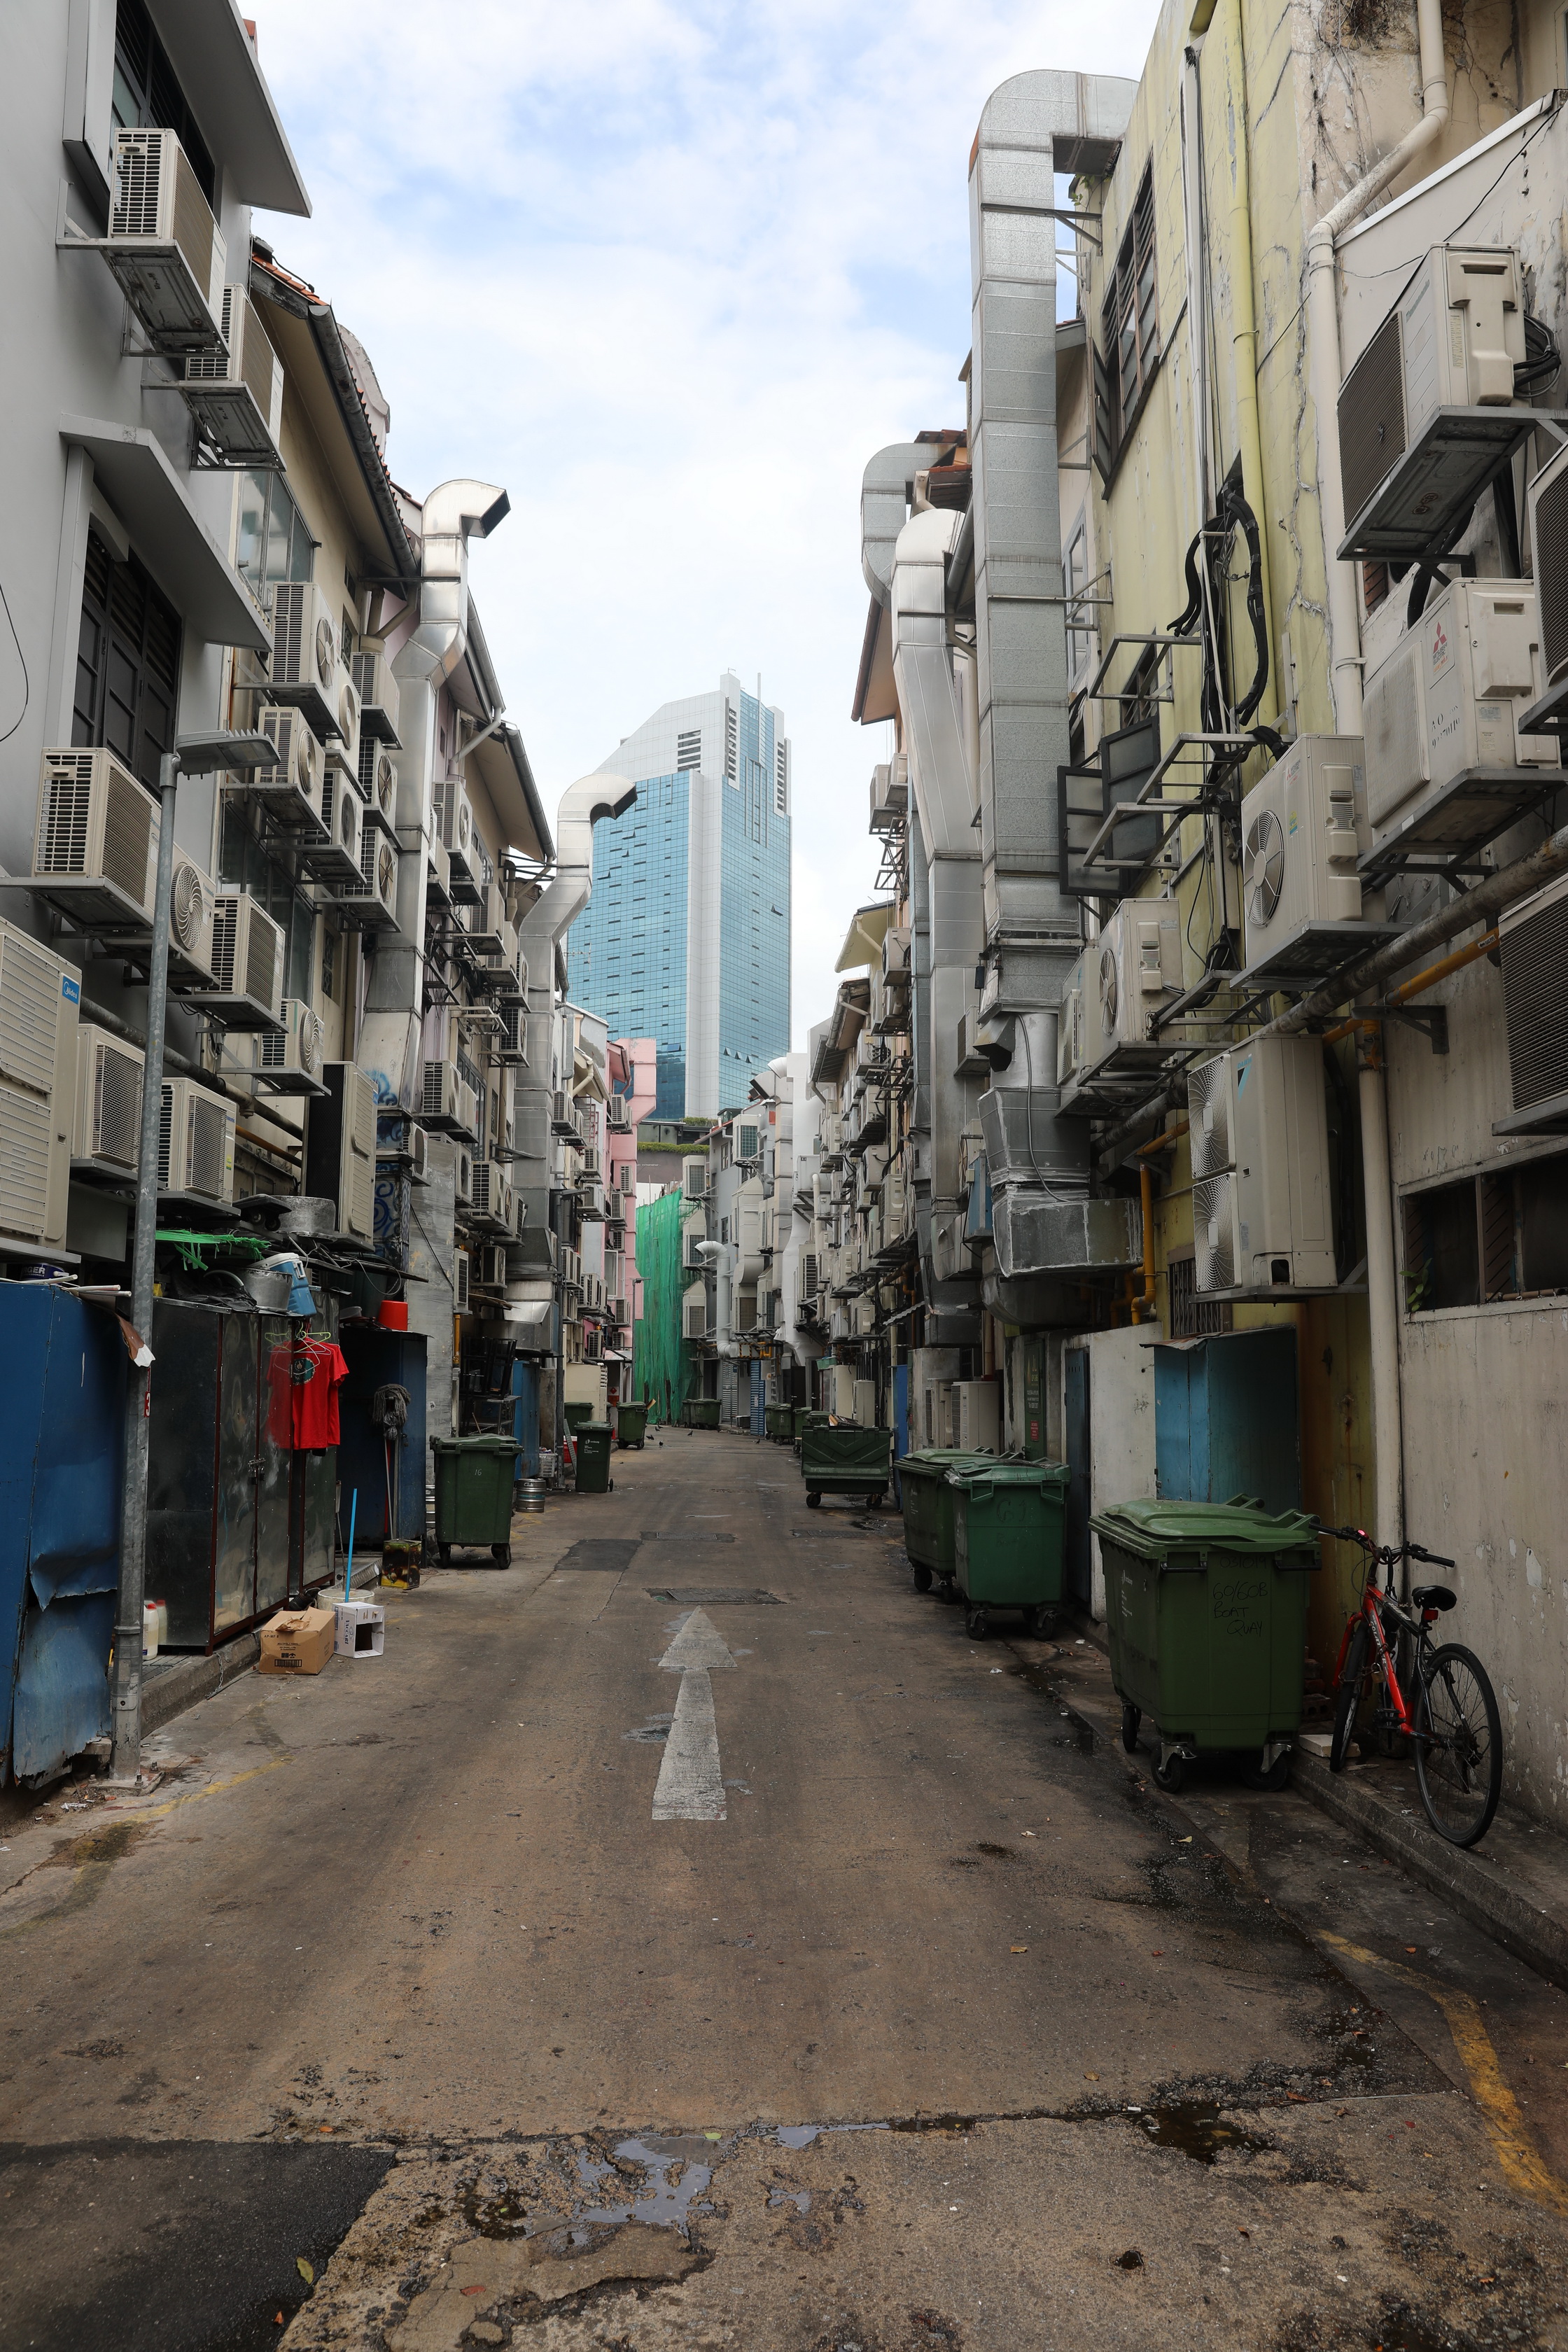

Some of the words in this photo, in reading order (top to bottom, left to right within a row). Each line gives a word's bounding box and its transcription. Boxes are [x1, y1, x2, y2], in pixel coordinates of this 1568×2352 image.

[64, 984, 77, 999] Midea
[475, 1468, 482, 1476] 16
[1212, 1581, 1268, 1602] 60/60B
[1214, 1600, 1250, 1619] BOAT
